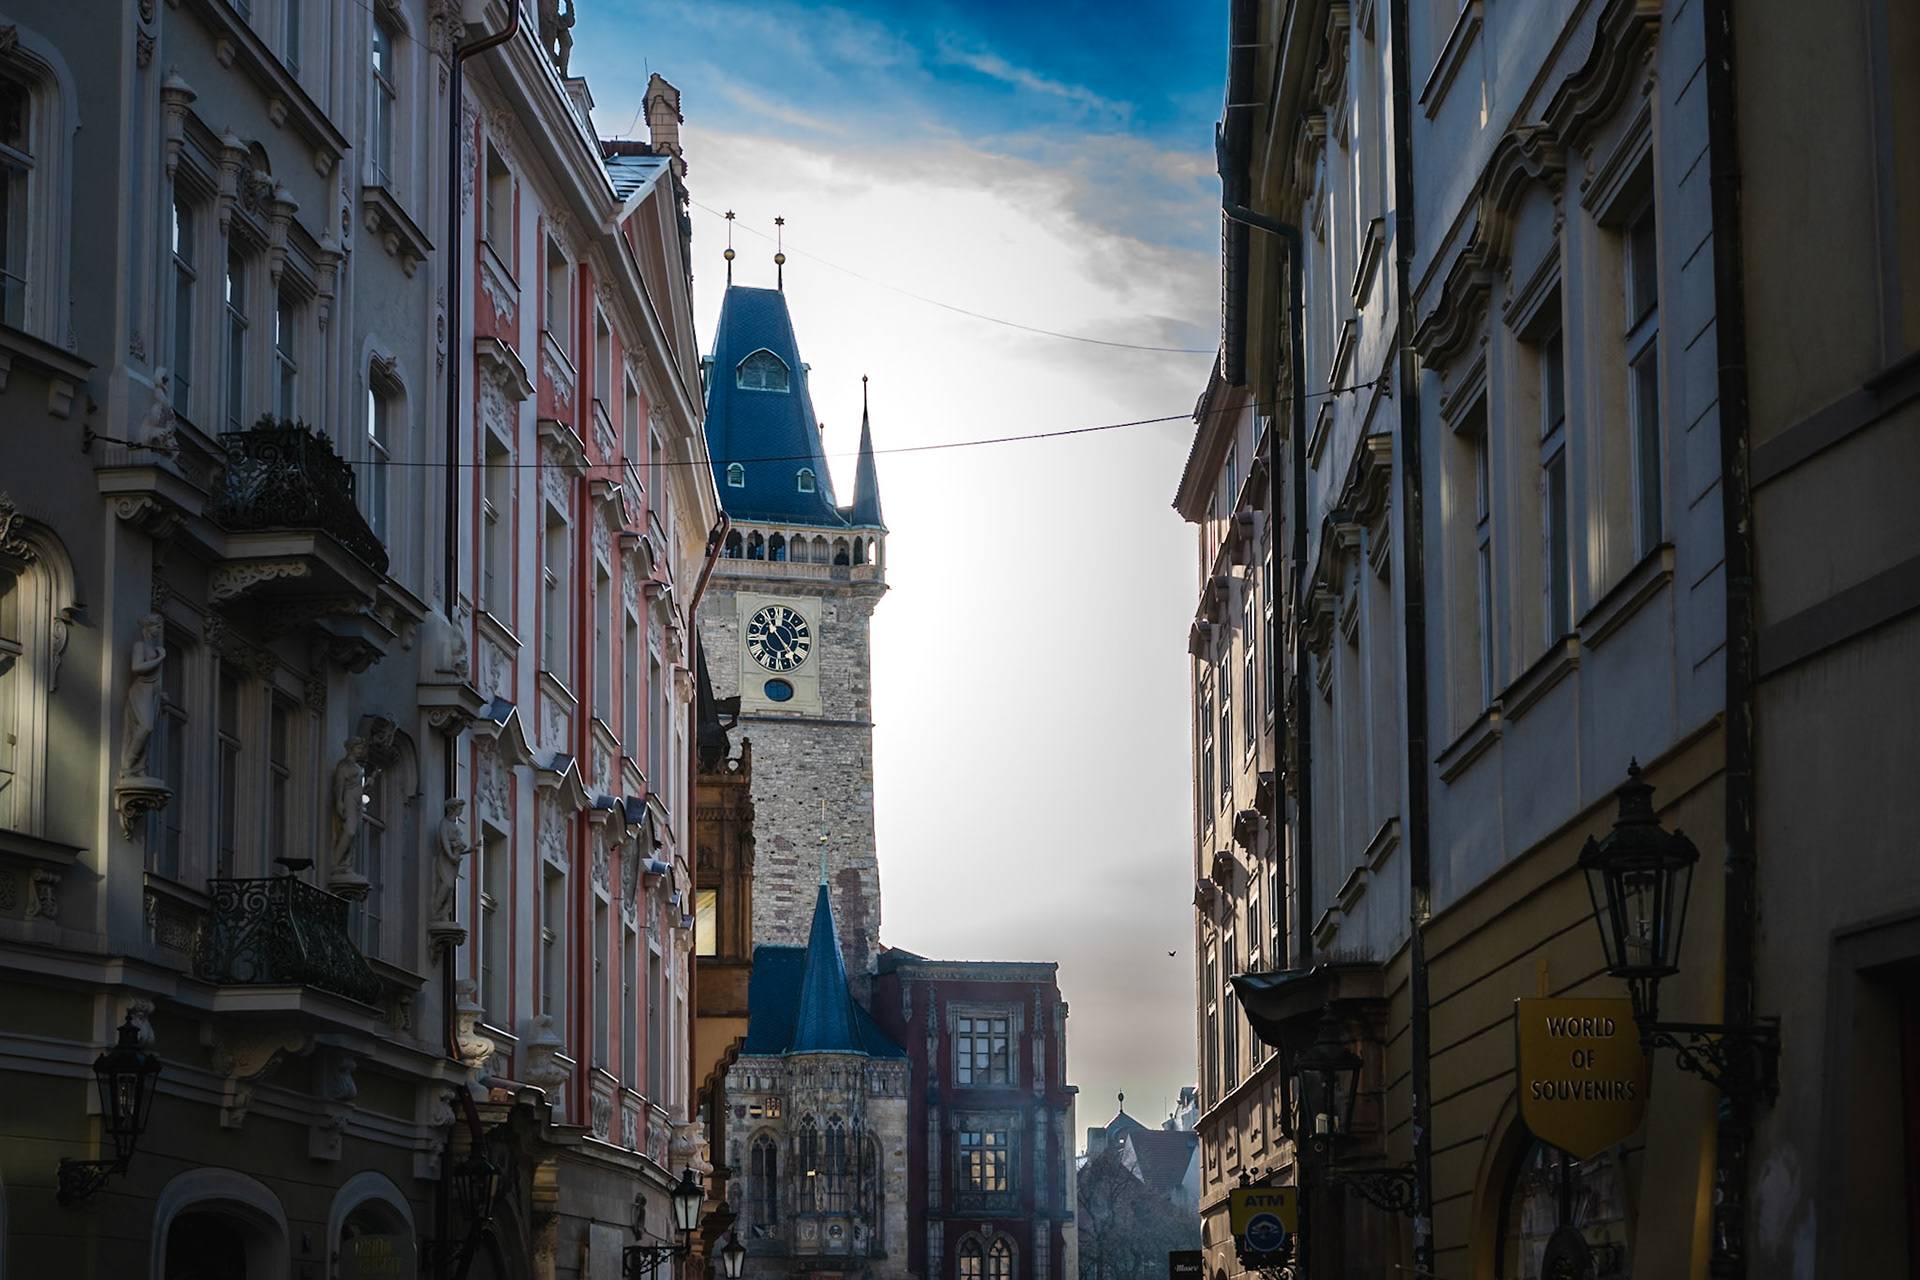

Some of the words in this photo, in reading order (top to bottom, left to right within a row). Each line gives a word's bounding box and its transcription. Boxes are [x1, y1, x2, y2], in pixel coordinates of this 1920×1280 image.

[1546, 1016, 1616, 1039] WORLD
[1571, 1049, 1596, 1070] OF
[1531, 1080, 1636, 1101] SOUVENIRS
[1245, 1194, 1285, 1207] ATM
